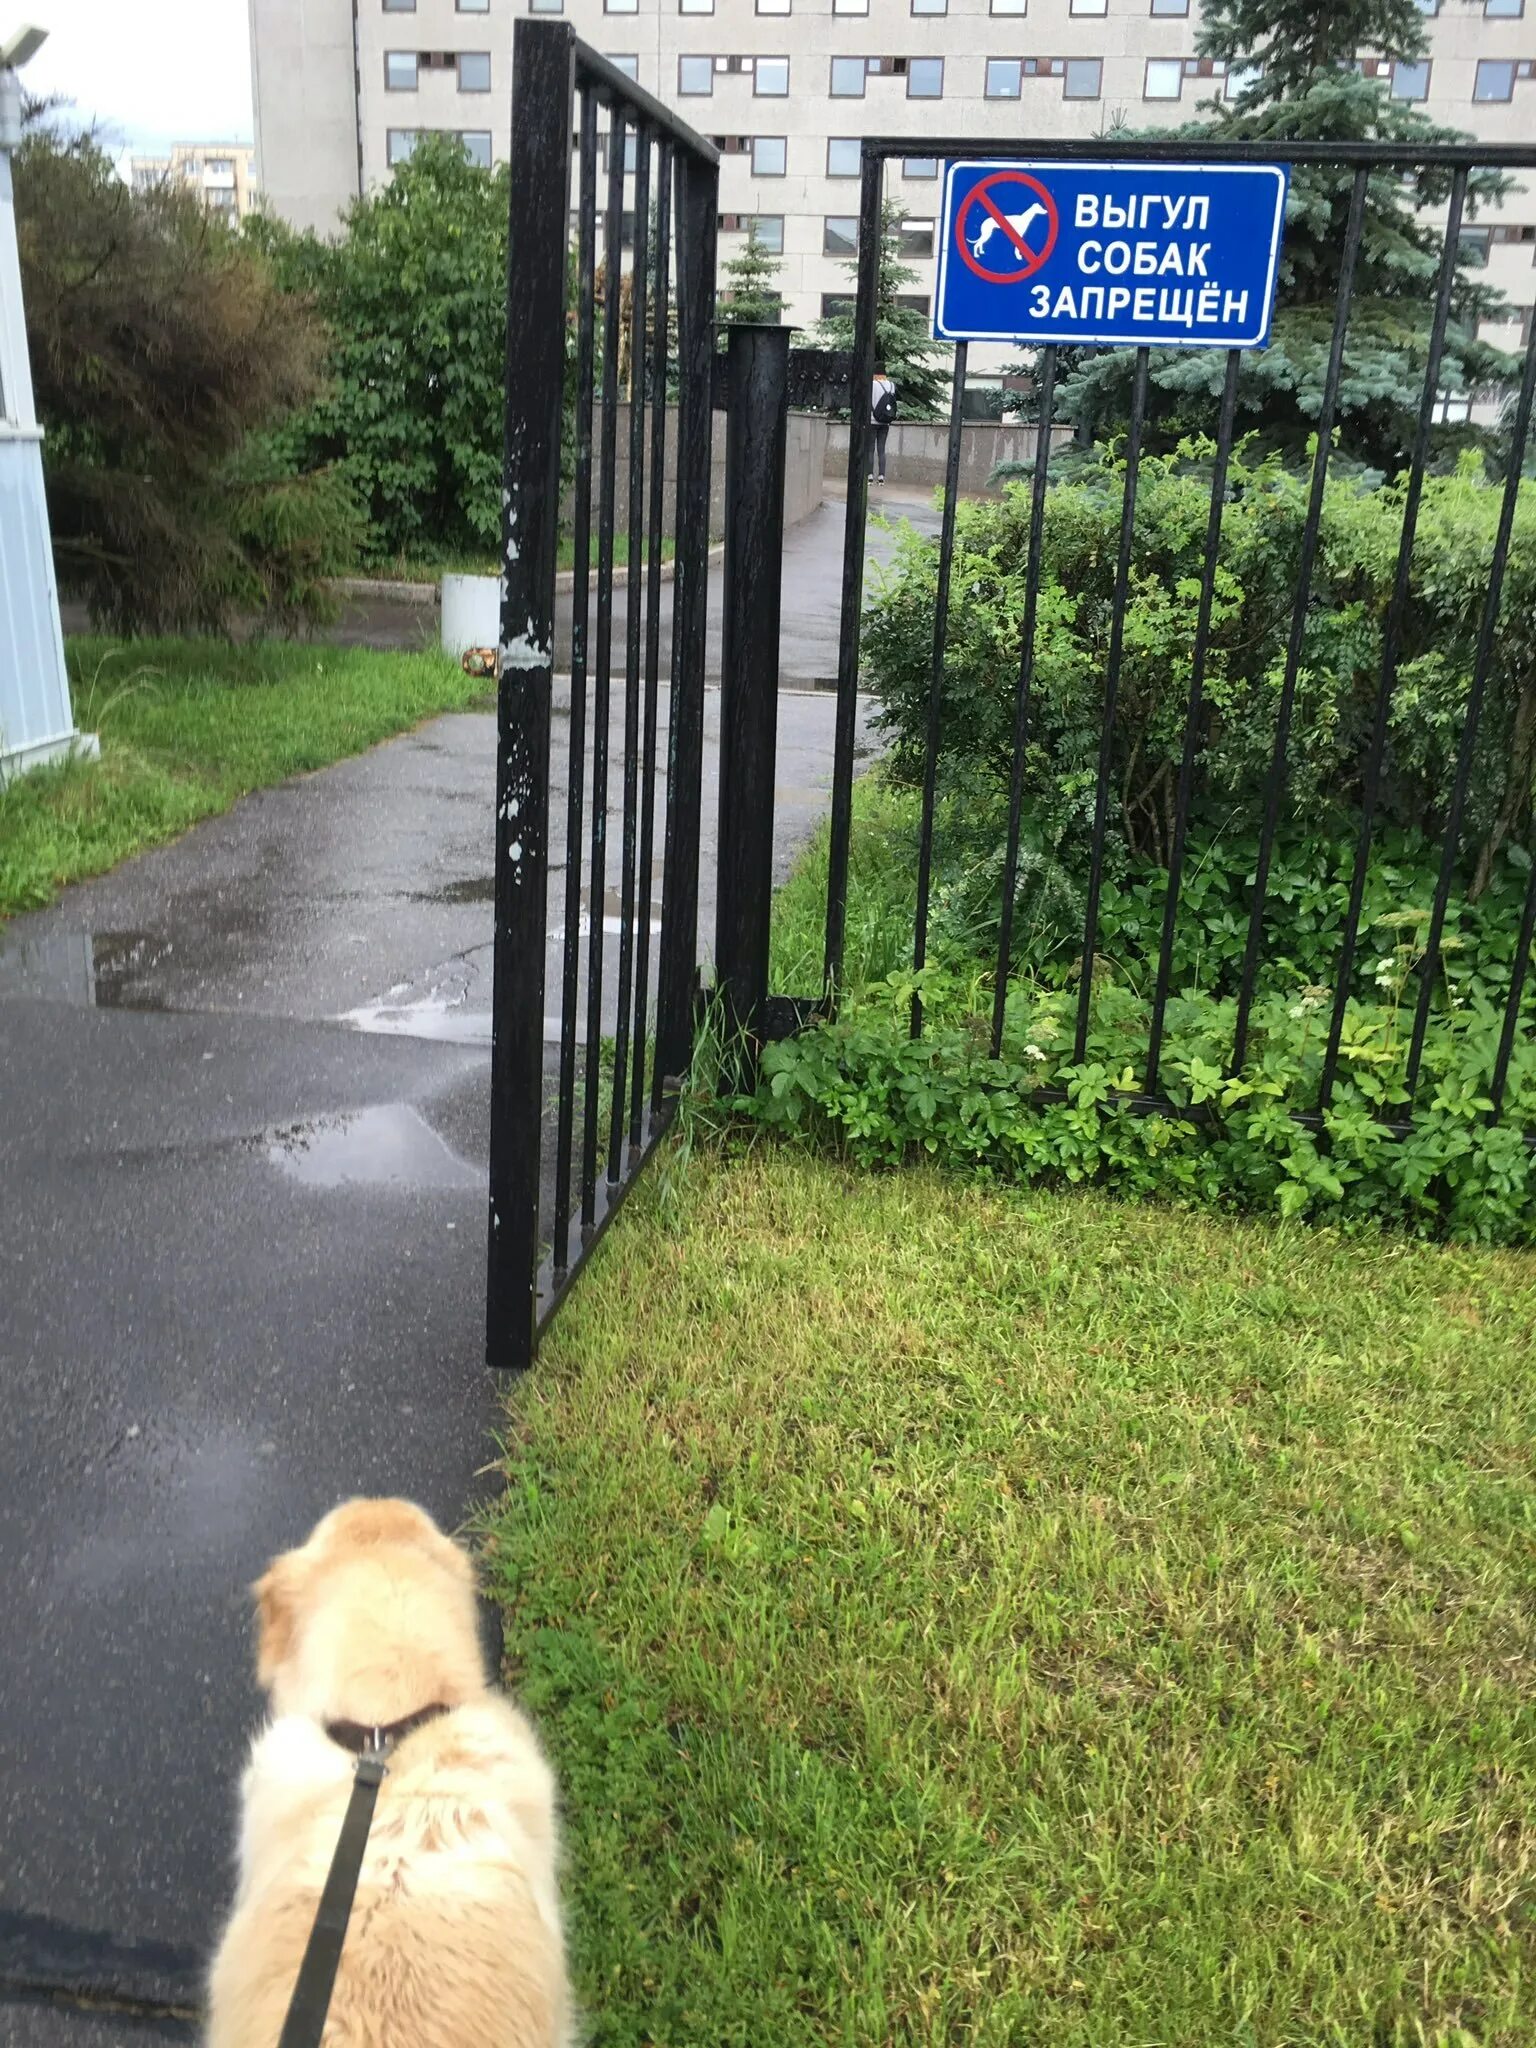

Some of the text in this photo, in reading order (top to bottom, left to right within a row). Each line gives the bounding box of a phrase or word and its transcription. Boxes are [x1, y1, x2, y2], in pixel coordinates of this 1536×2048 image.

[1074, 194, 1210, 230] ВЫГУЛ
[1077, 240, 1211, 276] СОБАК
[1028, 281, 1248, 328] ЗАПРЕЩЁН
